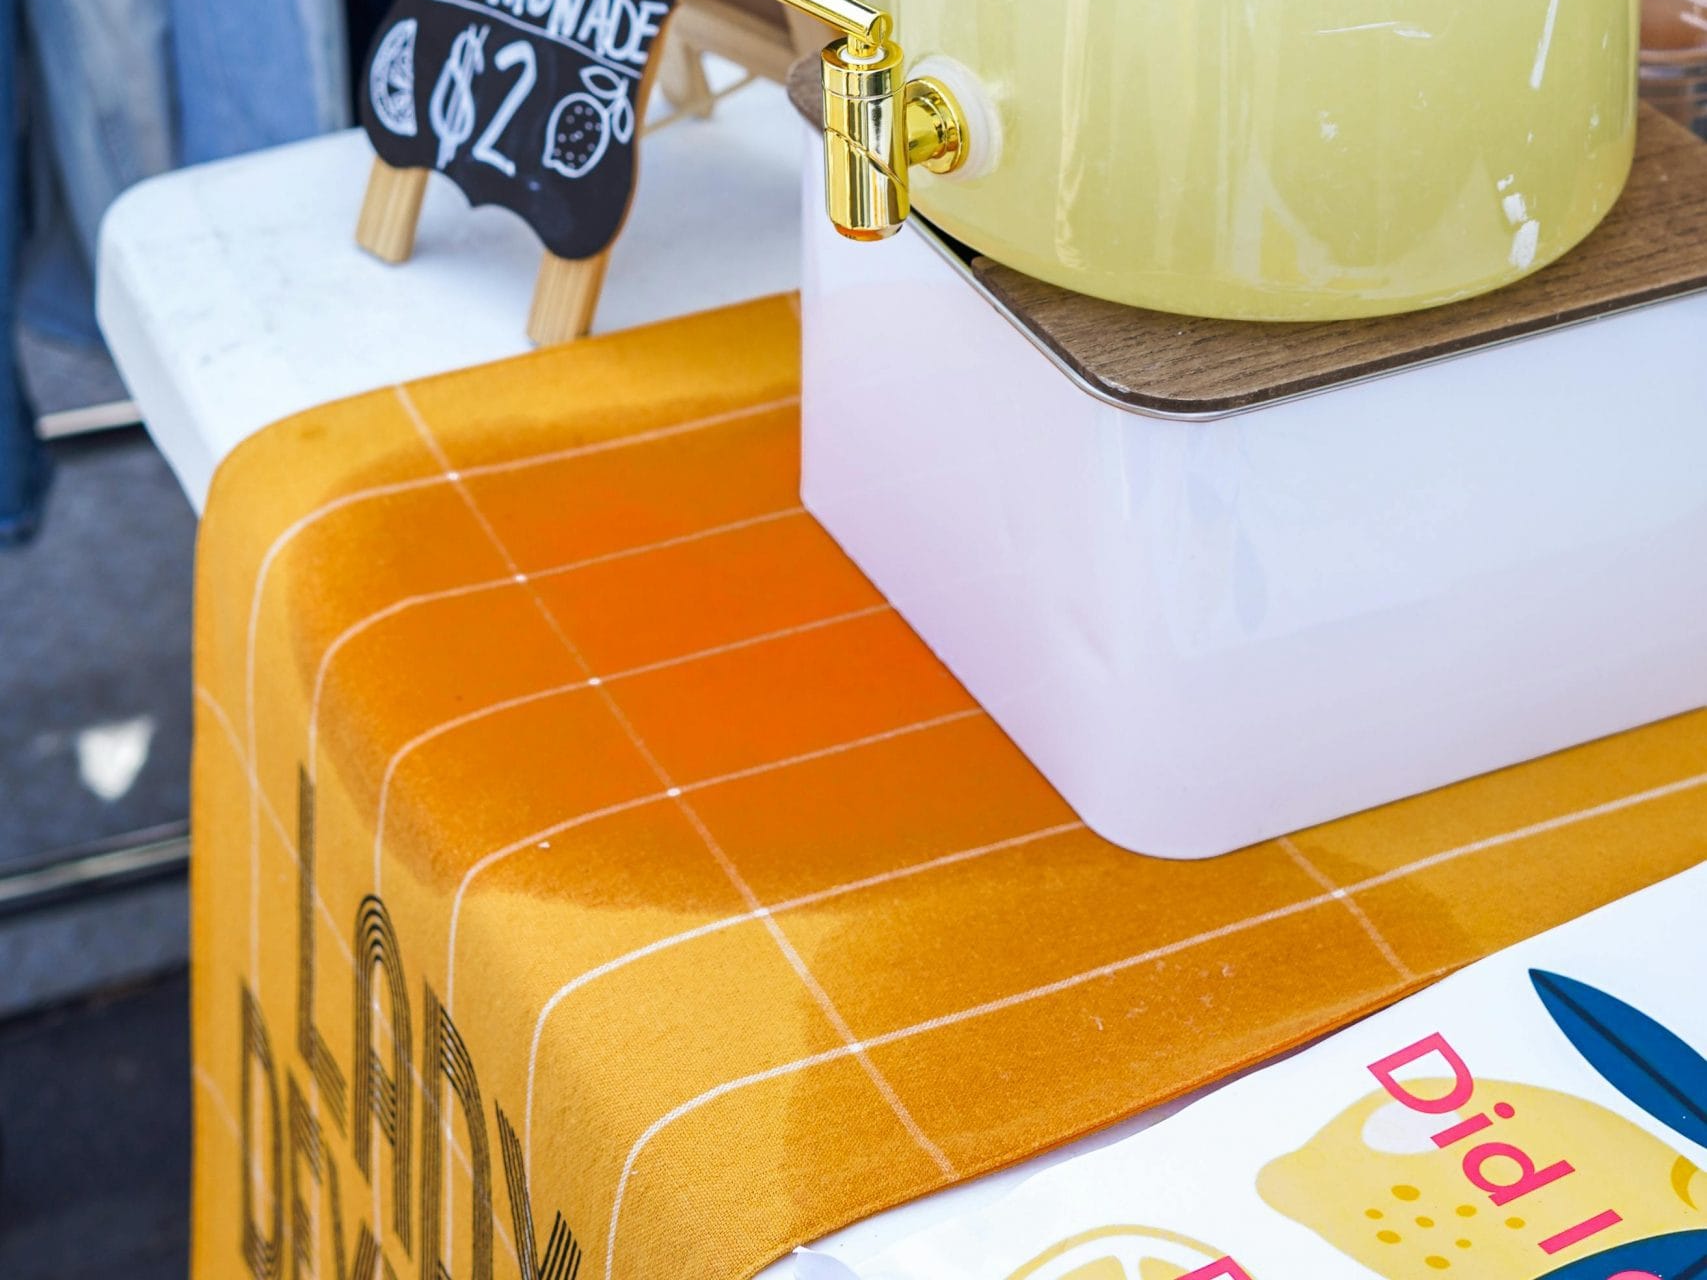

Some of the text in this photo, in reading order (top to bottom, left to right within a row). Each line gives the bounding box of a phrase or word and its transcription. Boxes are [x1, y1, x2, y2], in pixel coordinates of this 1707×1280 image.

[429, 23, 538, 178] $2
[1367, 1031, 1624, 1255] Did I
